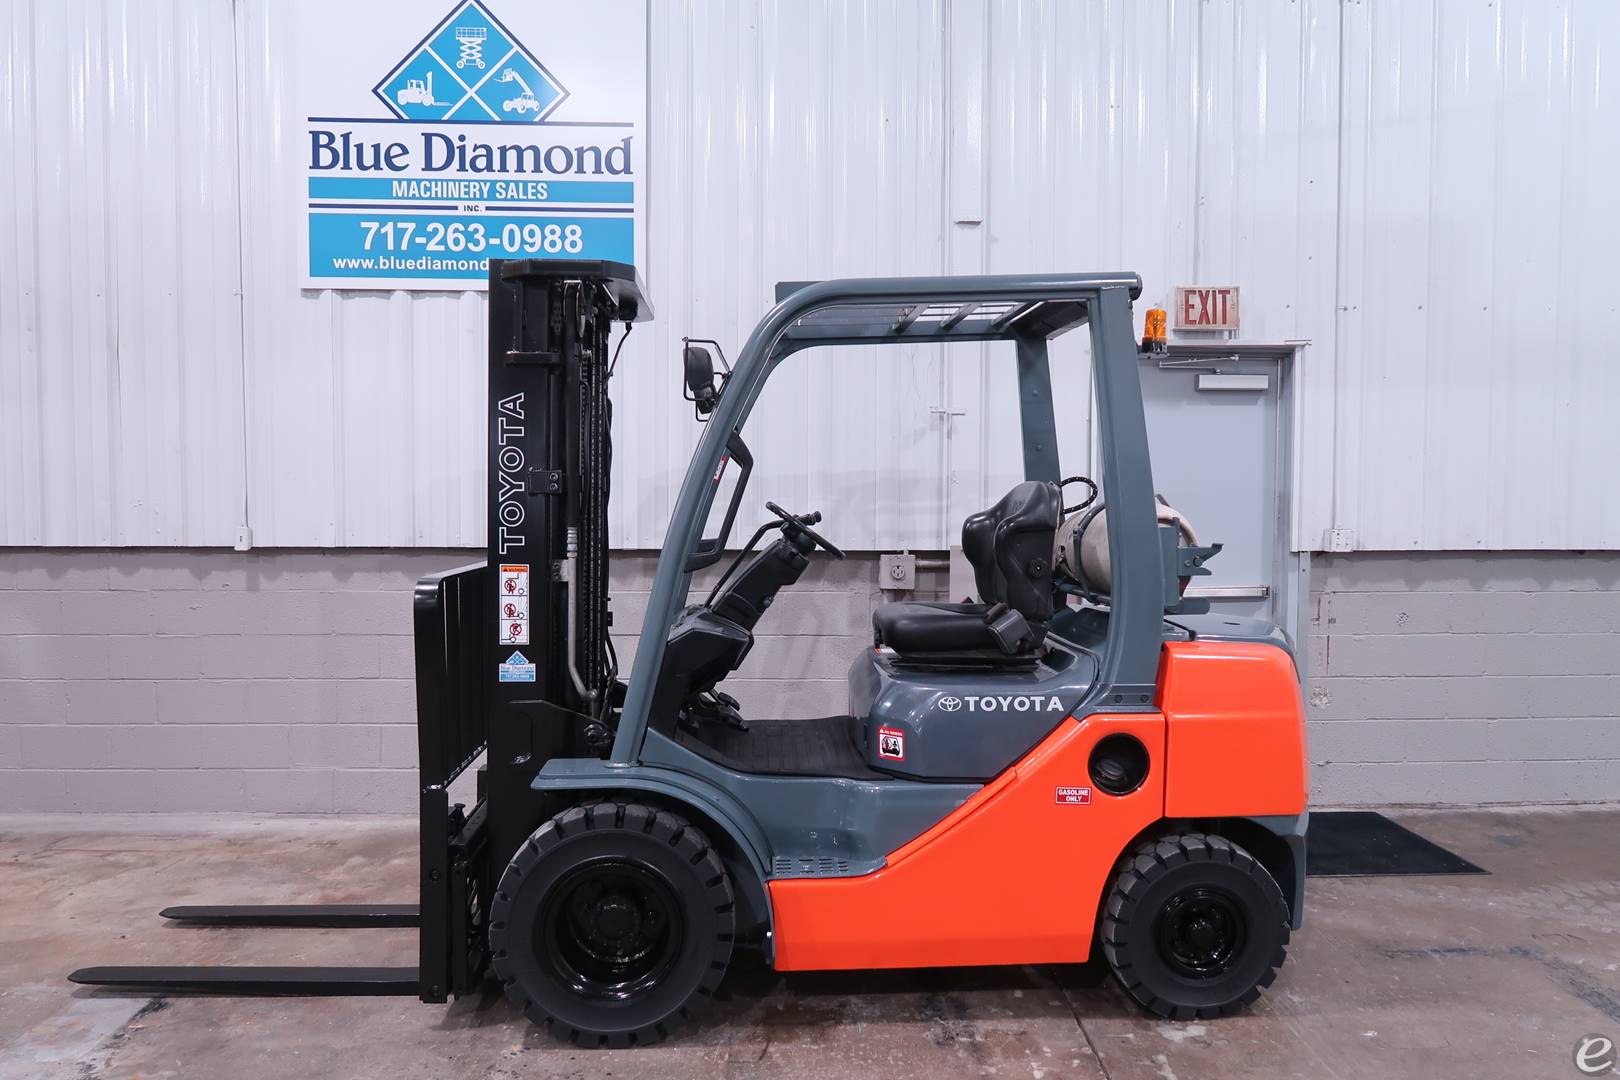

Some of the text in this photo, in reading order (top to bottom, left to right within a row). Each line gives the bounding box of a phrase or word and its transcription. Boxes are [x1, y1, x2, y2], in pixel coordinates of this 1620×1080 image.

[309, 130, 633, 175] Blue Diamond
[392, 180, 548, 200] MACHINERY SALES
[360, 221, 583, 253] 717-263-0988
[1184, 289, 1230, 325] EXIT
[498, 392, 525, 555] TOYOTA
[964, 696, 1064, 712] TOYOTA
